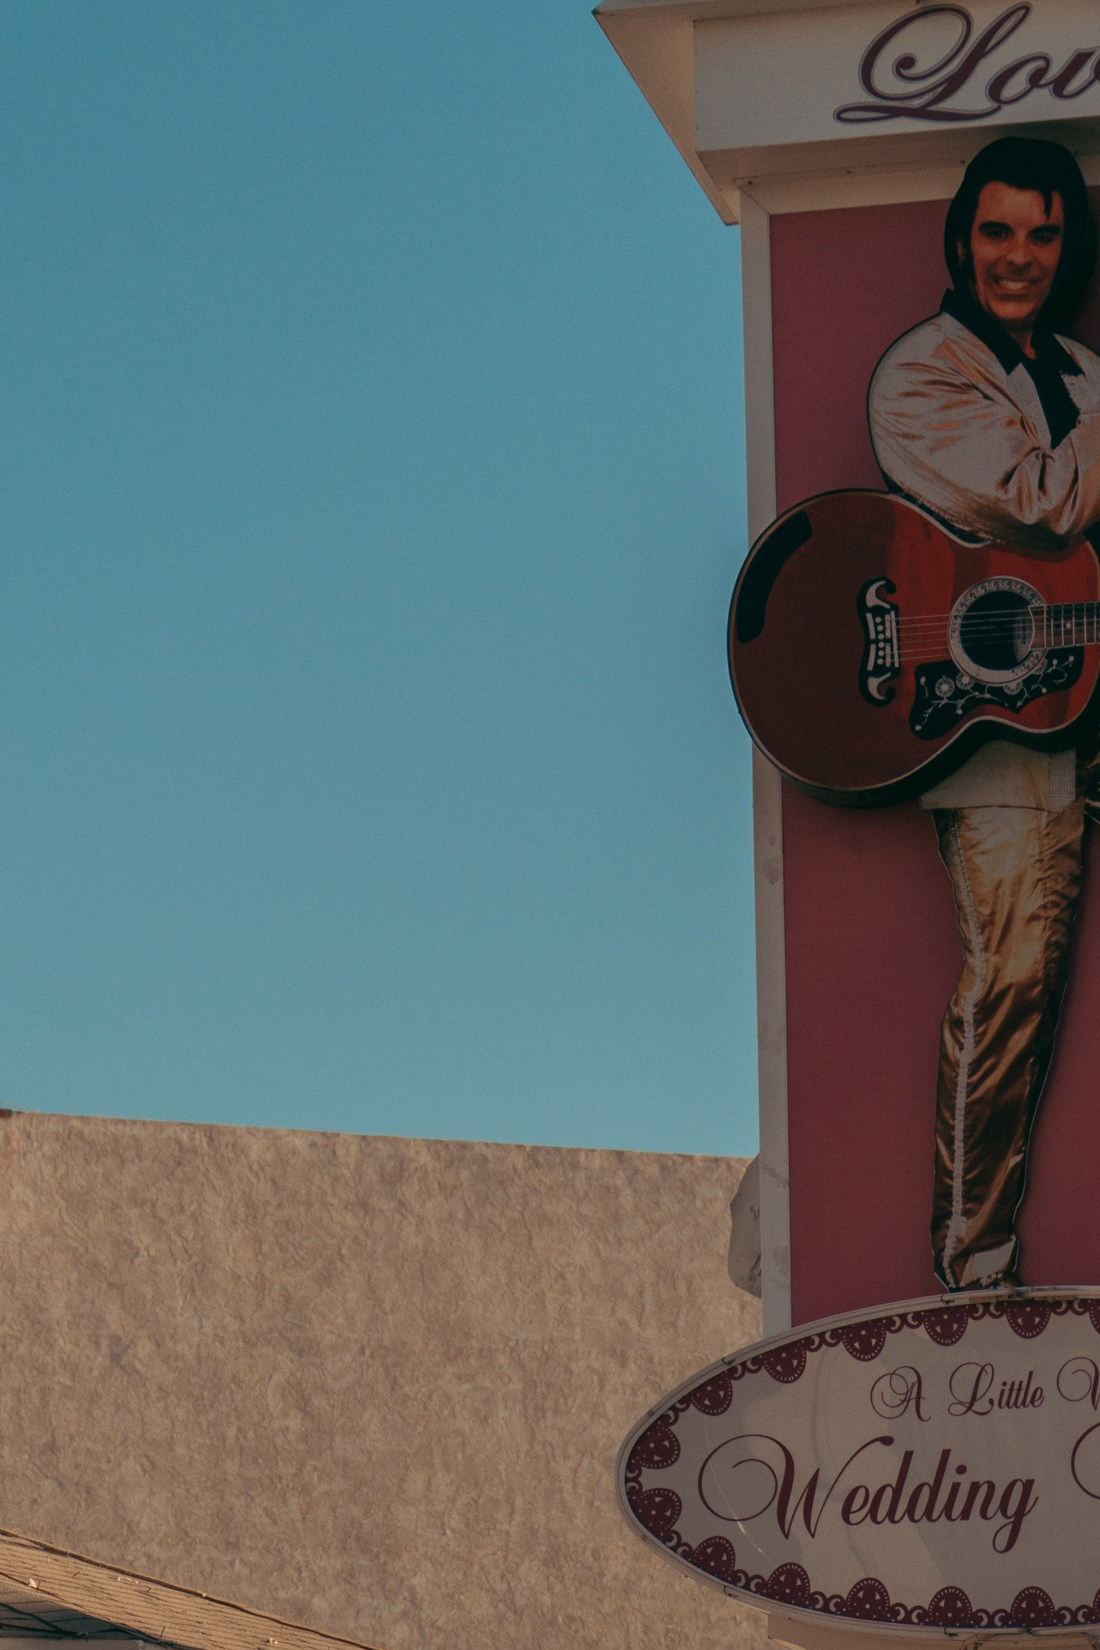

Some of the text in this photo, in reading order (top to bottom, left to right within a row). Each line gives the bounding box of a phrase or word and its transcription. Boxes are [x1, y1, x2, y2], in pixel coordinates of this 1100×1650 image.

[870, 1366, 931, 1422] A
[948, 1362, 1045, 1417] Little
[697, 1434, 1039, 1554] Wedding
